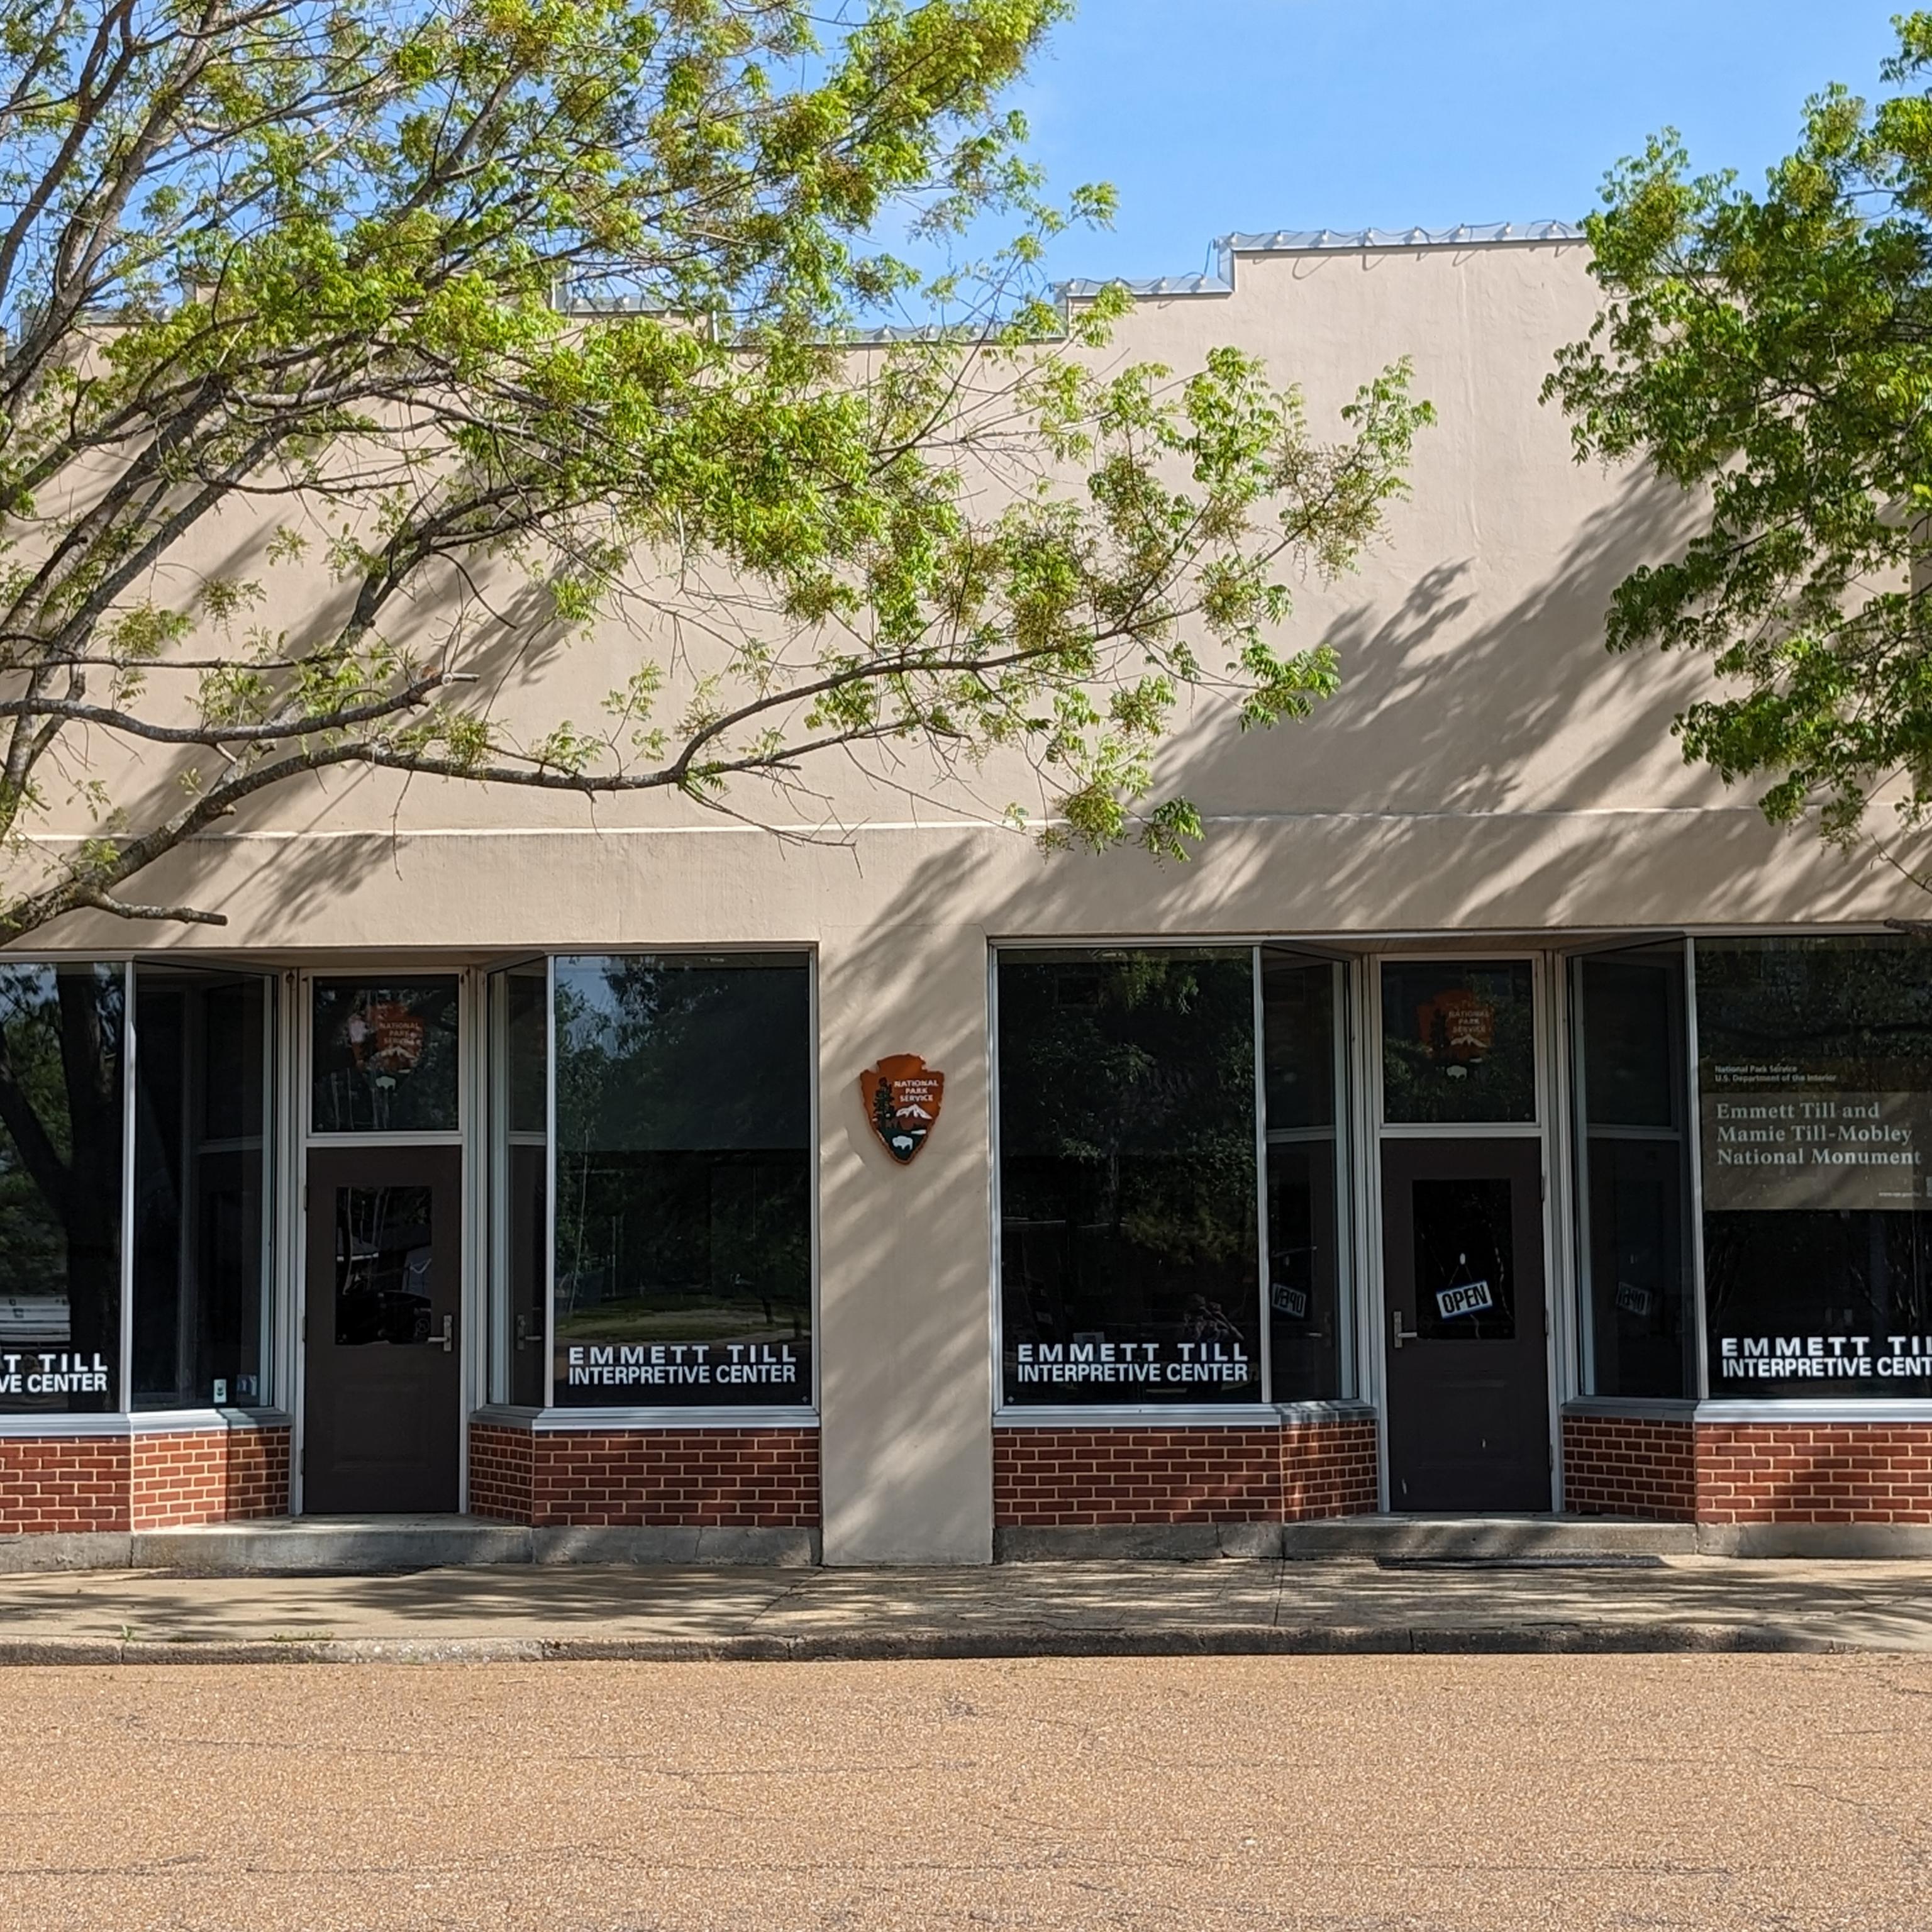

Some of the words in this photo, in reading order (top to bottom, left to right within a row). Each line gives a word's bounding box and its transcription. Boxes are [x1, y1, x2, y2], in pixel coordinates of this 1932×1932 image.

[1714, 1065, 1748, 1073] National
[1750, 1065, 1768, 1073] Park
[1769, 1065, 1798, 1073] Service
[894, 1079, 939, 1087] NATIONAL
[1714, 1074, 1730, 1082] U.S.
[1732, 1074, 1780, 1084] Department
[1781, 1074, 1790, 1082] of
[1792, 1074, 1806, 1082] the
[1807, 1074, 1837, 1082] Interior
[899, 1094, 934, 1102] SERVICE
[1717, 1103, 1795, 1119] Emmett
[1799, 1102, 1836, 1119] Till
[1842, 1102, 1880, 1119] and
[1717, 1125, 1785, 1143] Mamie
[1790, 1124, 1912, 1146] Till-Mobley
[1718, 1148, 1804, 1165] National
[1812, 1148, 1922, 1165] Monument
[1441, 1284, 1489, 1313] OPEN
[569, 1345, 709, 1365] EMMETT
[726, 1344, 796, 1363] TILL
[1018, 1343, 1159, 1362] EMMETT
[1177, 1343, 1248, 1362] TILL
[1721, 1336, 1870, 1357] EMMETT
[38, 1353, 108, 1373] TILL
[1018, 1363, 1161, 1382] INTERPRETIVE
[1166, 1363, 1248, 1382] CENTER
[1722, 1357, 1872, 1378] INTERPRETIVE
[27, 1373, 108, 1393] CENTER
[569, 1365, 711, 1385] INTERPRETIVE
[716, 1365, 796, 1384] CENTER
